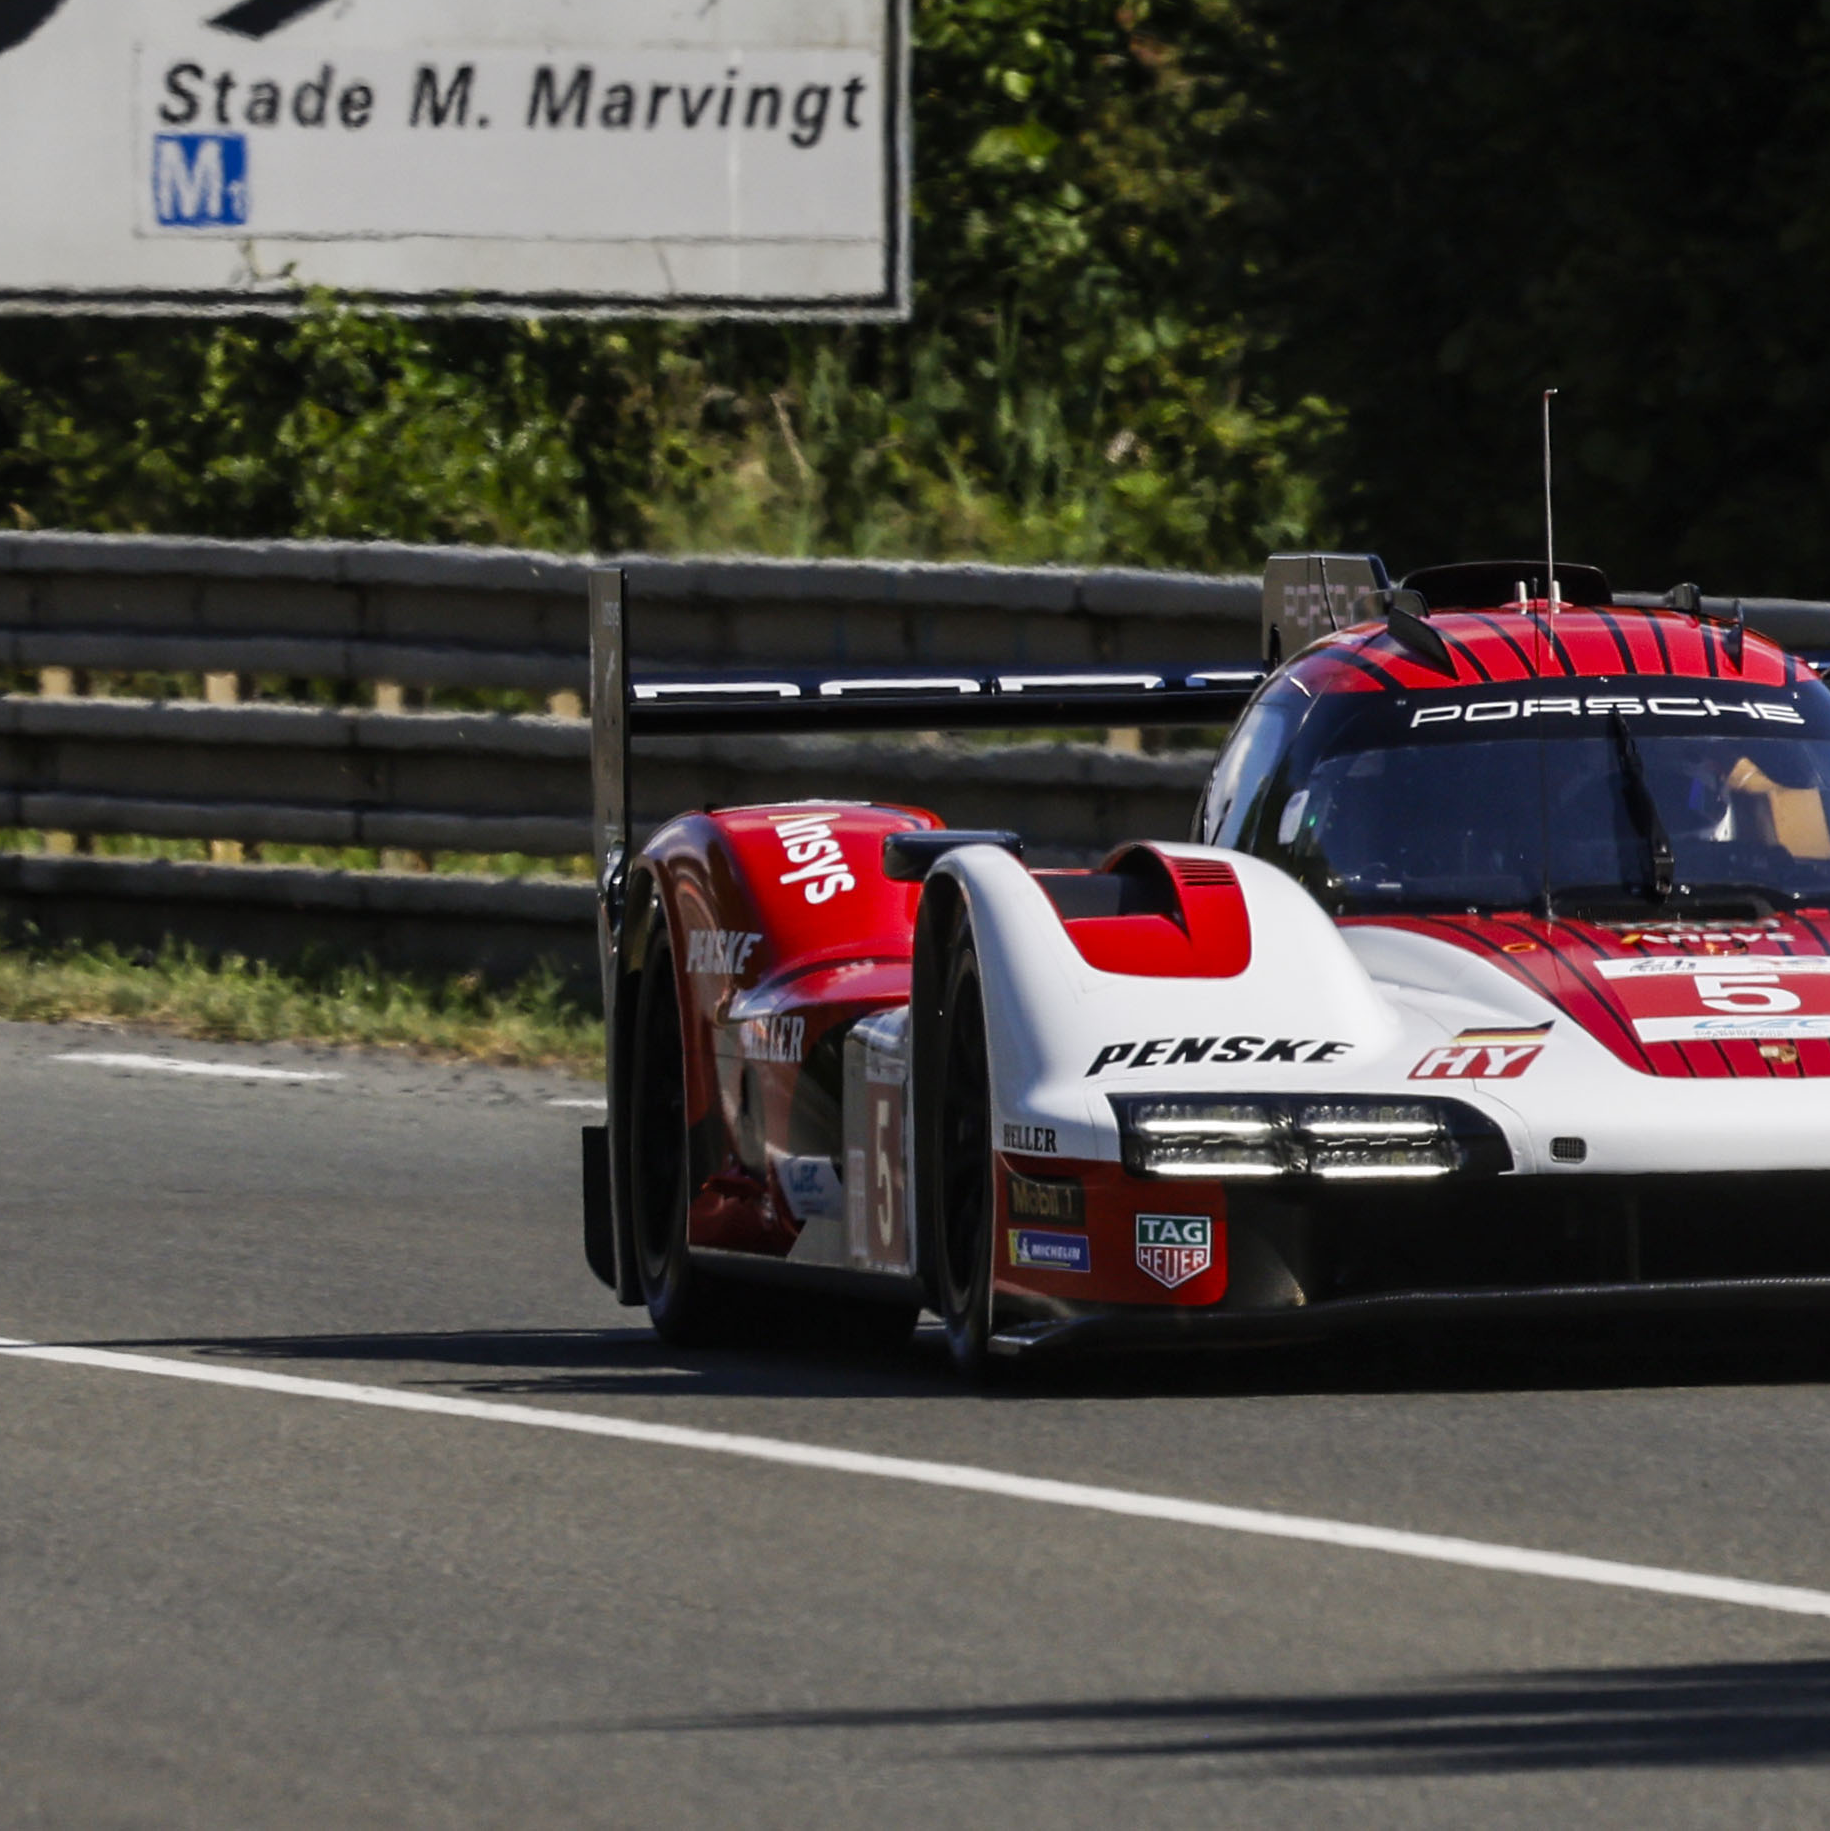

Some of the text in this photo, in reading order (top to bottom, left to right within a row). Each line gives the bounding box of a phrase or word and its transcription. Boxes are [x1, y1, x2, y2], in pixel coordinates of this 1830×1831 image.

[158, 61, 866, 149] Stade M. Marvingt
[1409, 697, 1806, 728] PORSCHE
[1693, 974, 1802, 1013] 5
[1084, 1036, 1354, 1077] PENSKE
[1414, 1046, 1539, 1077] HY
[1002, 1123, 1058, 1154] HELLER
[876, 1099, 894, 1247] 5
[1141, 1219, 1204, 1243] TAG
[1030, 1243, 1082, 1262] MICHELIN
[1139, 1248, 1205, 1283] HEUER
